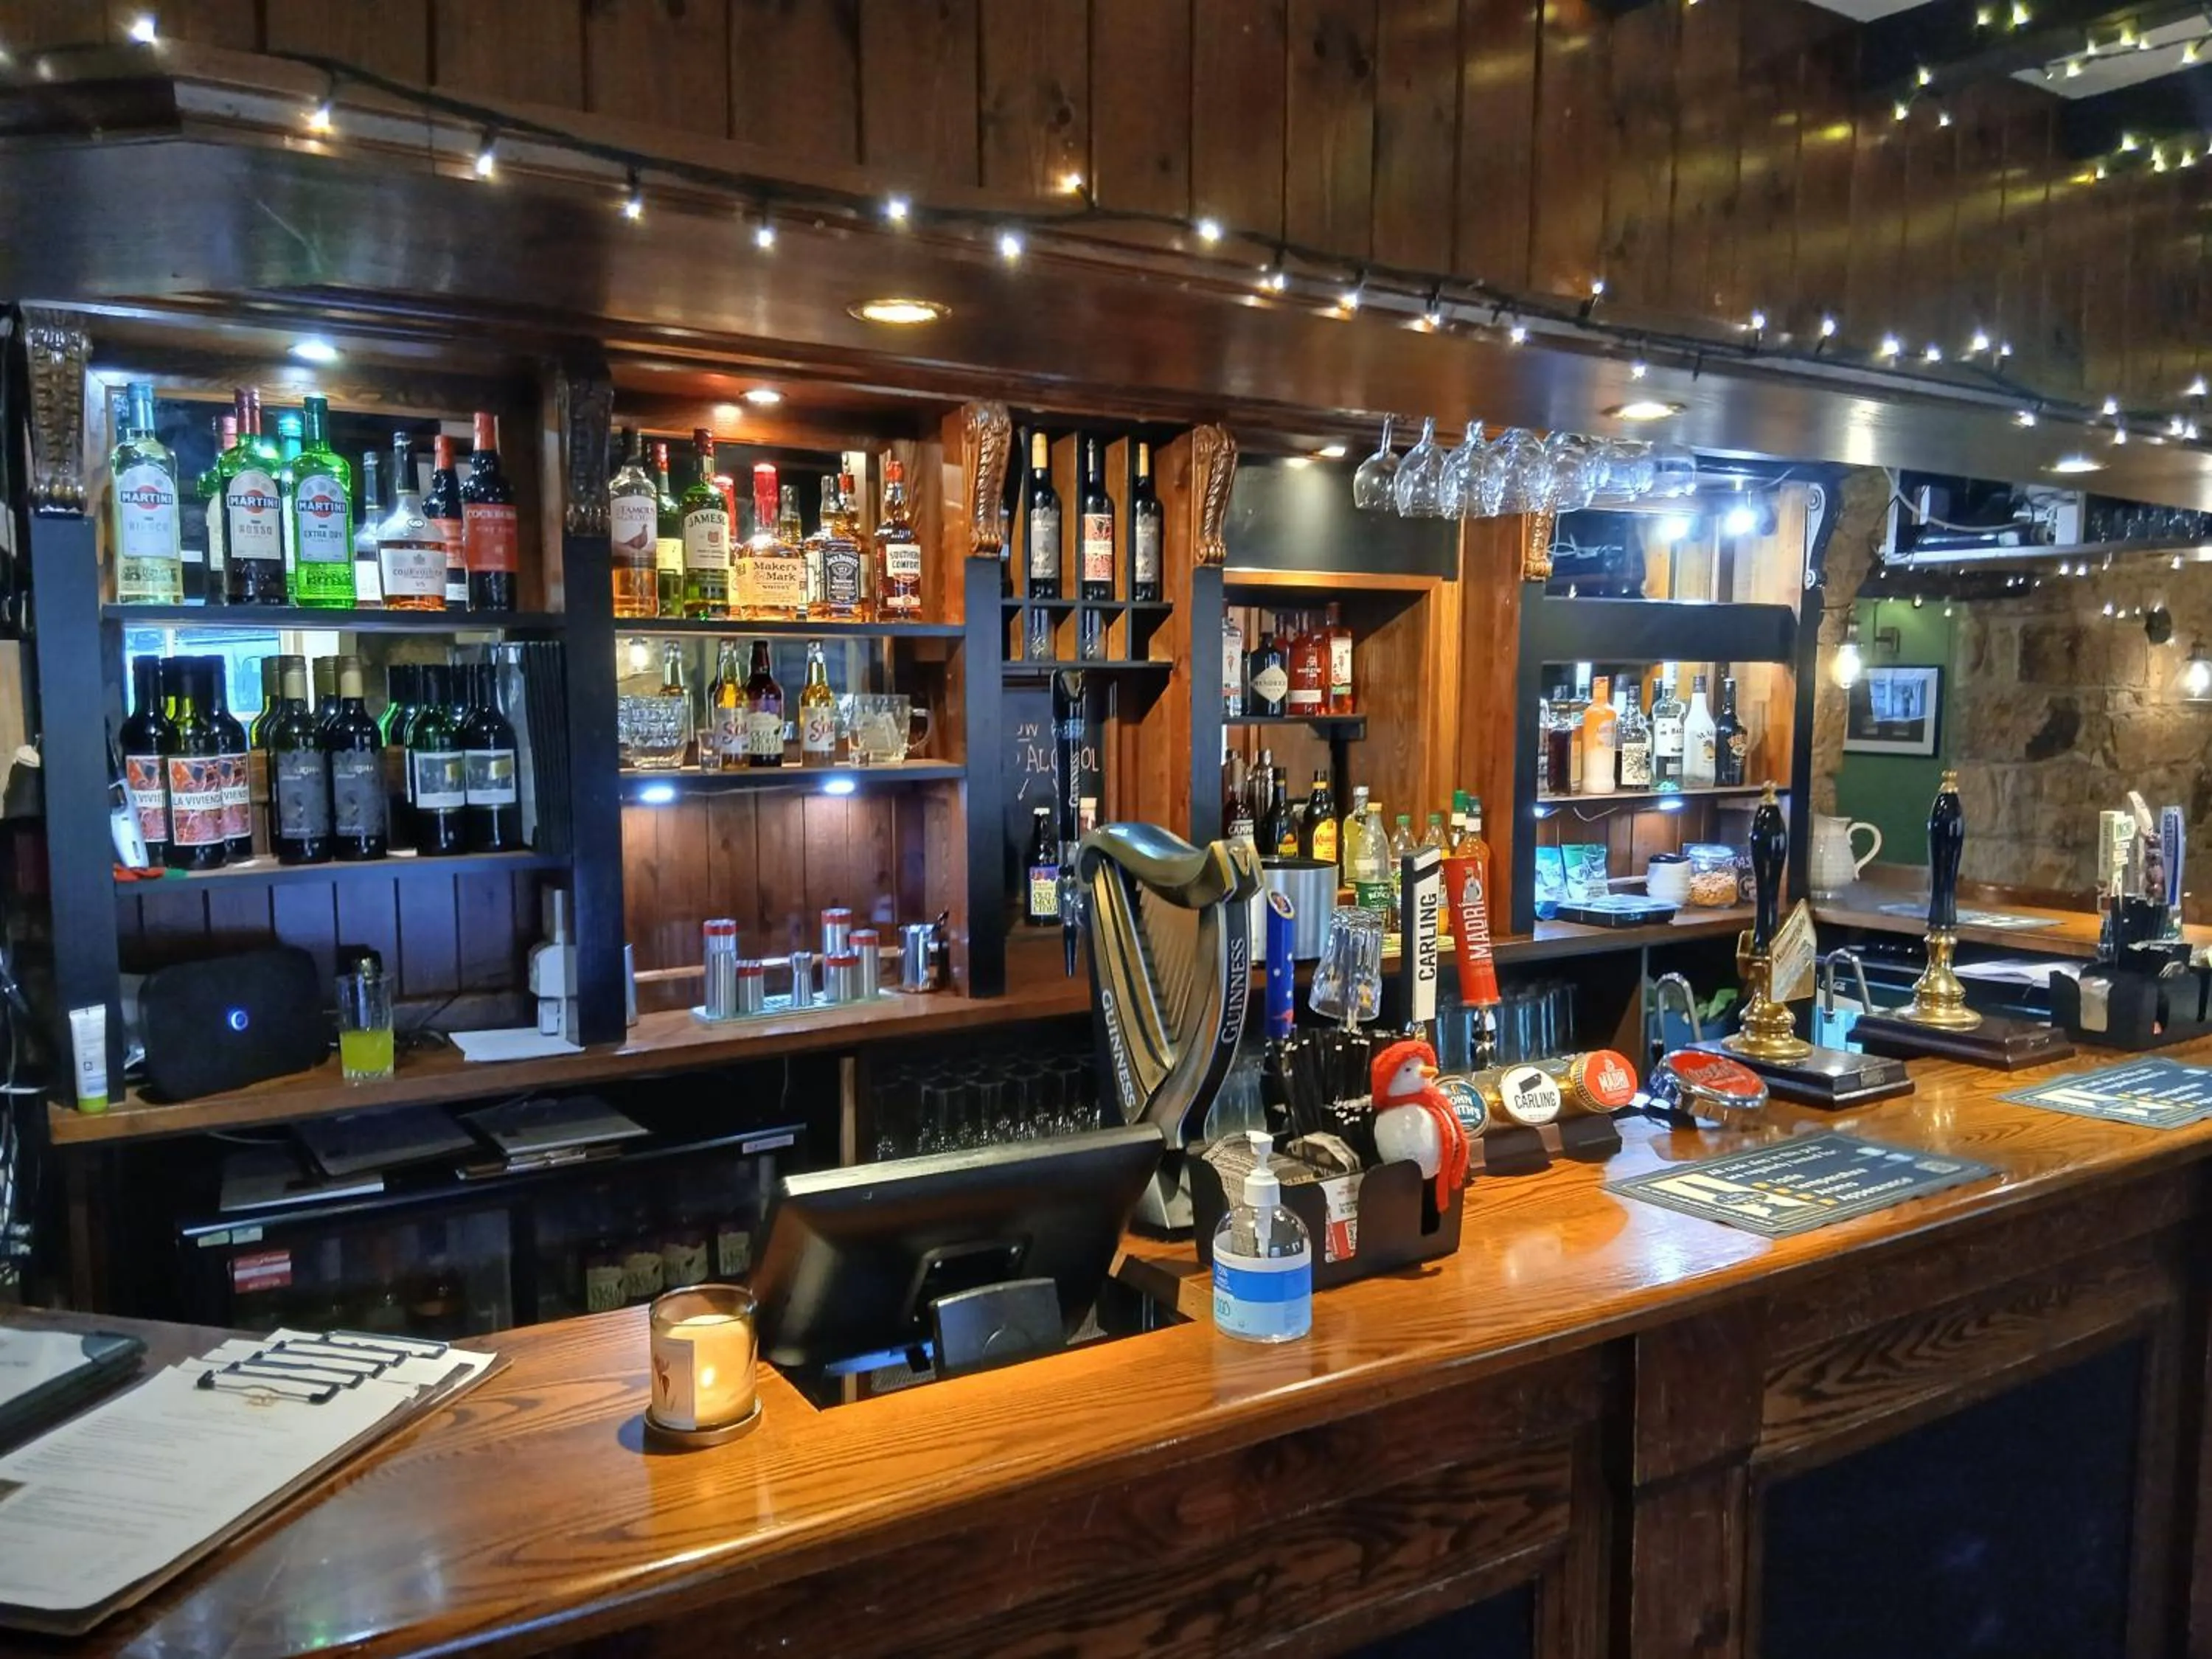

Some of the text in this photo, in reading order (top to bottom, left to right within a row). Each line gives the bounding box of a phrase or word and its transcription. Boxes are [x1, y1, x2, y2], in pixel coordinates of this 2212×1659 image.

[121, 492, 172, 504] MARTINI
[229, 495, 279, 509] MARTINI
[299, 501, 347, 513] MARTINI
[766, 571, 797, 581] Mark
[1026, 744, 1099, 773] ALCOL
[1418, 893, 1437, 981] CARLING
[1220, 937, 1245, 1044] GUINNESS
[1102, 989, 1137, 1108] GUINNESS
[1451, 1095, 1472, 1105] OHN
[1514, 1091, 1557, 1110] CARLING
